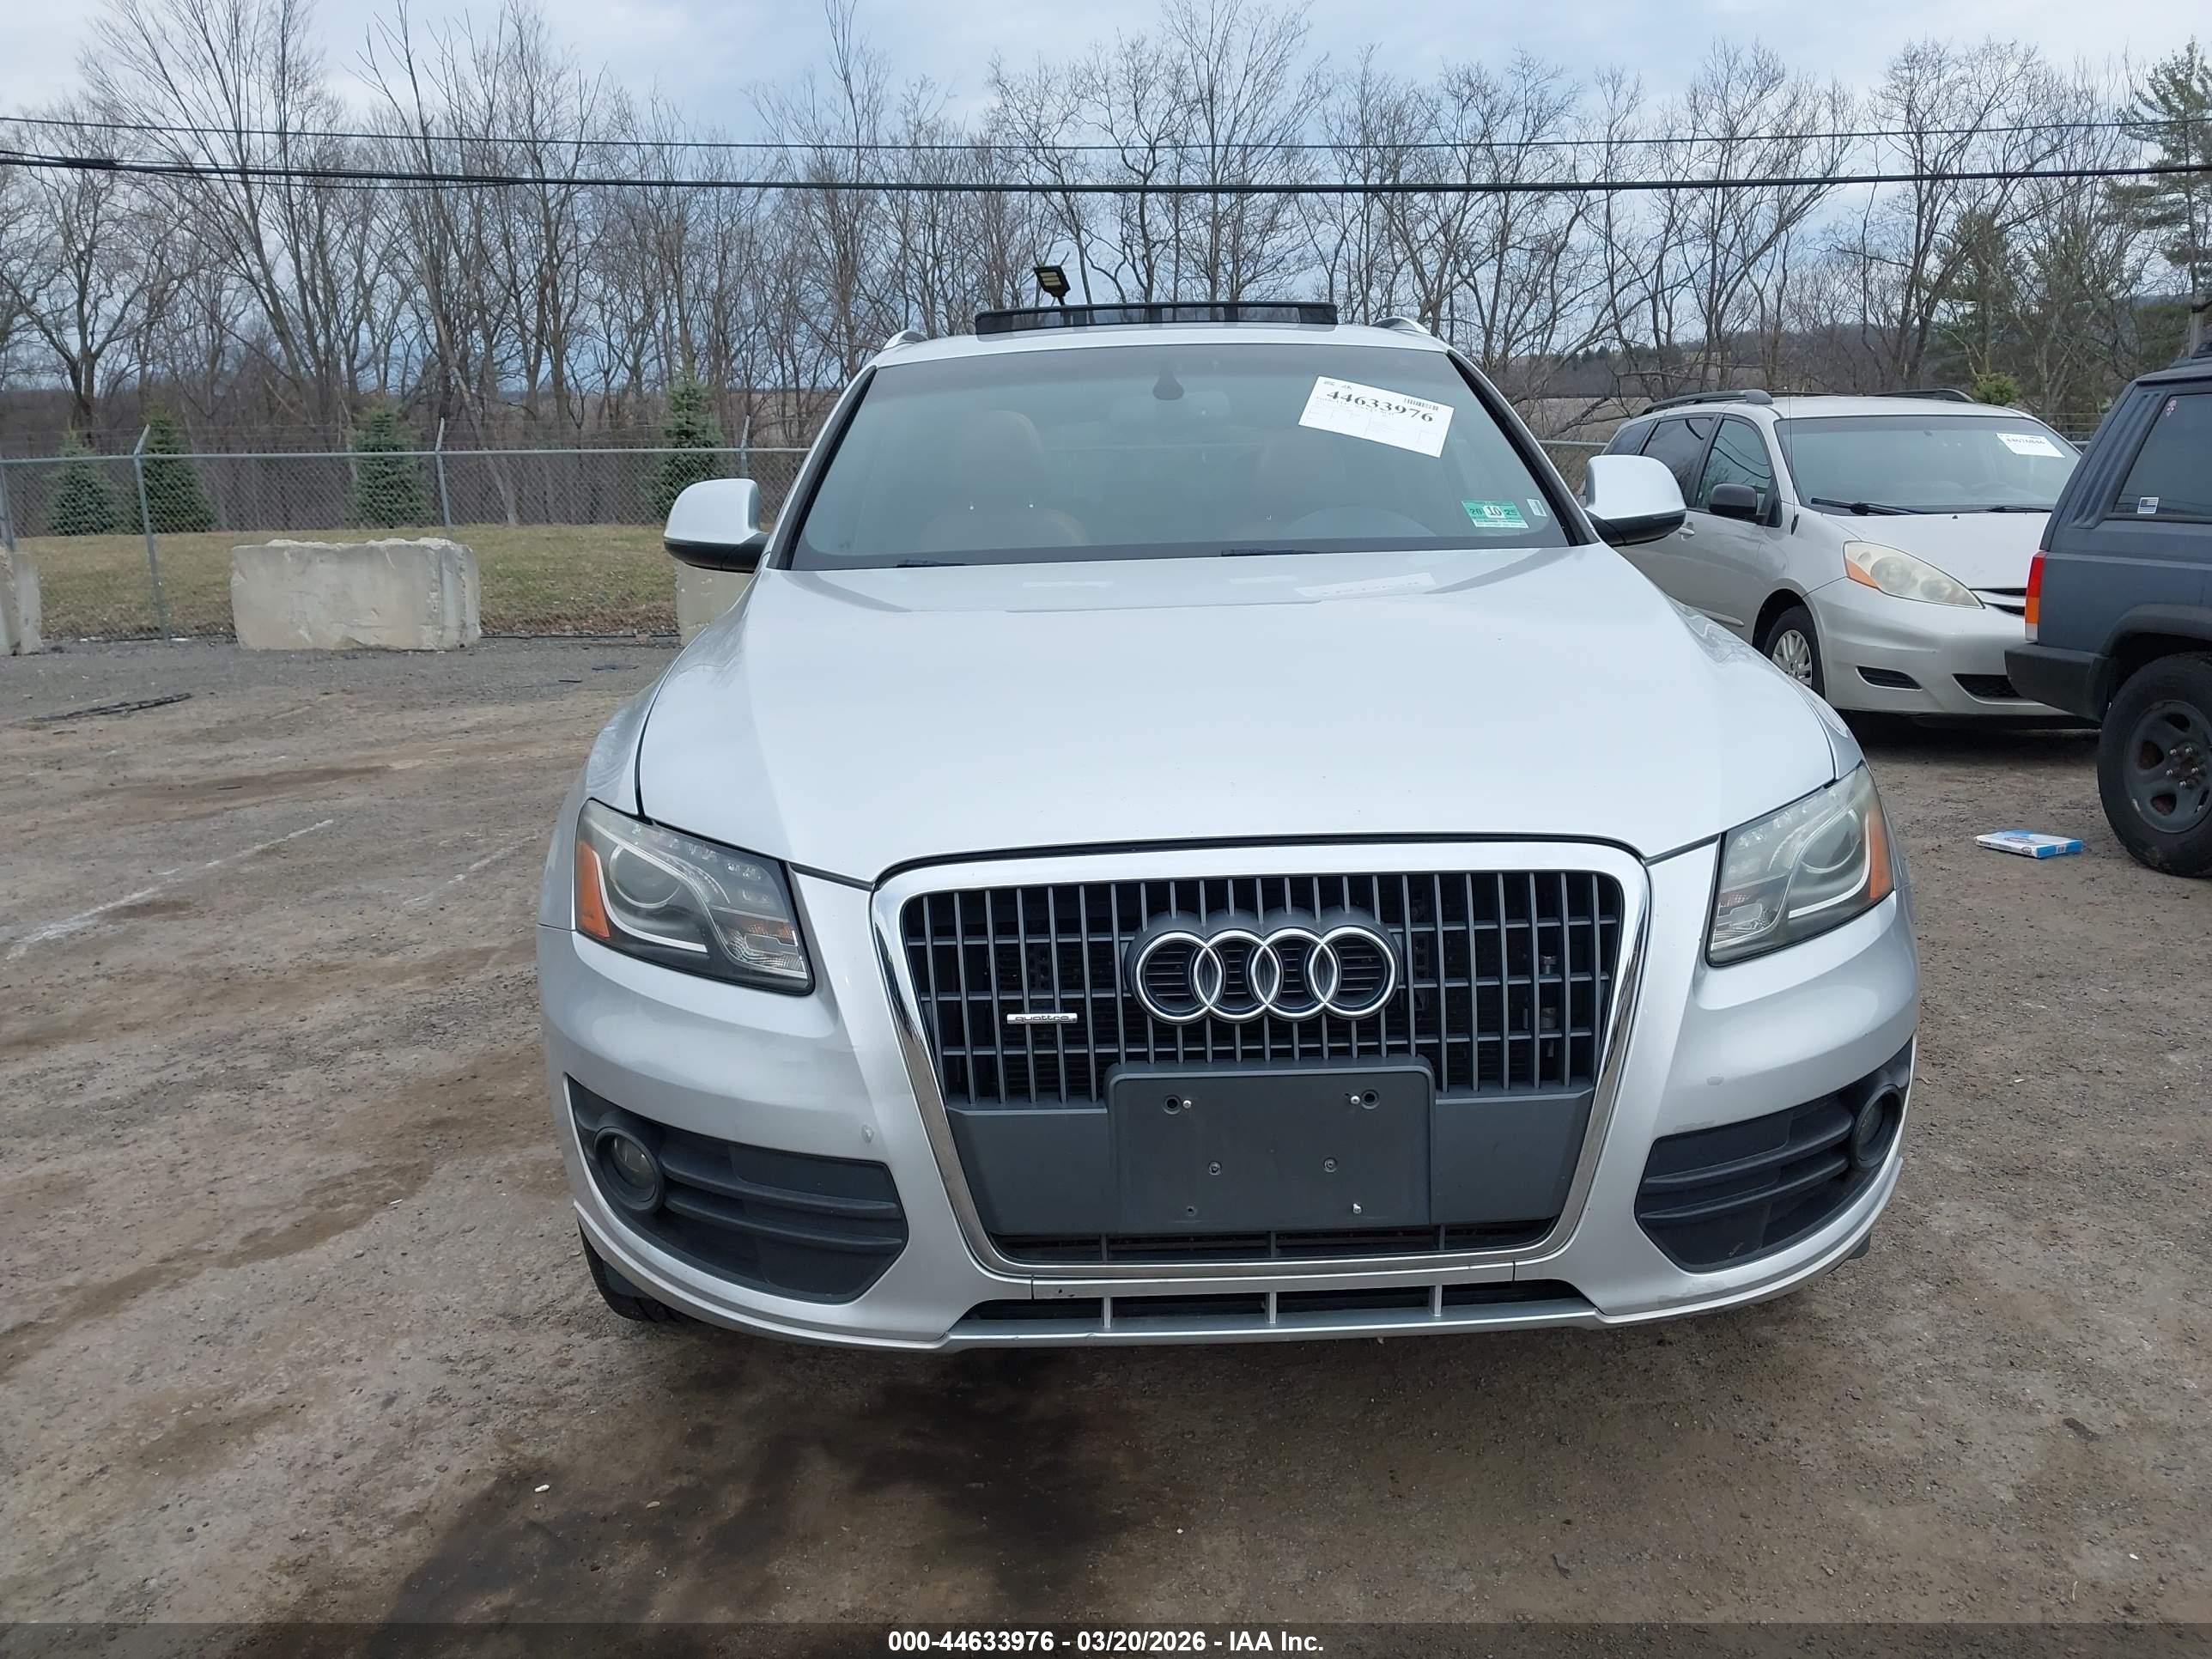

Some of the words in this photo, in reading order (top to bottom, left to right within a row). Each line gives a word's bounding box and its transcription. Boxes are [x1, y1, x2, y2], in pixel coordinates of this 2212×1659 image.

[1326, 391, 1434, 422] 44633976
[1486, 506, 1503, 516] 10
[1015, 1014, 1070, 1023] quattro
